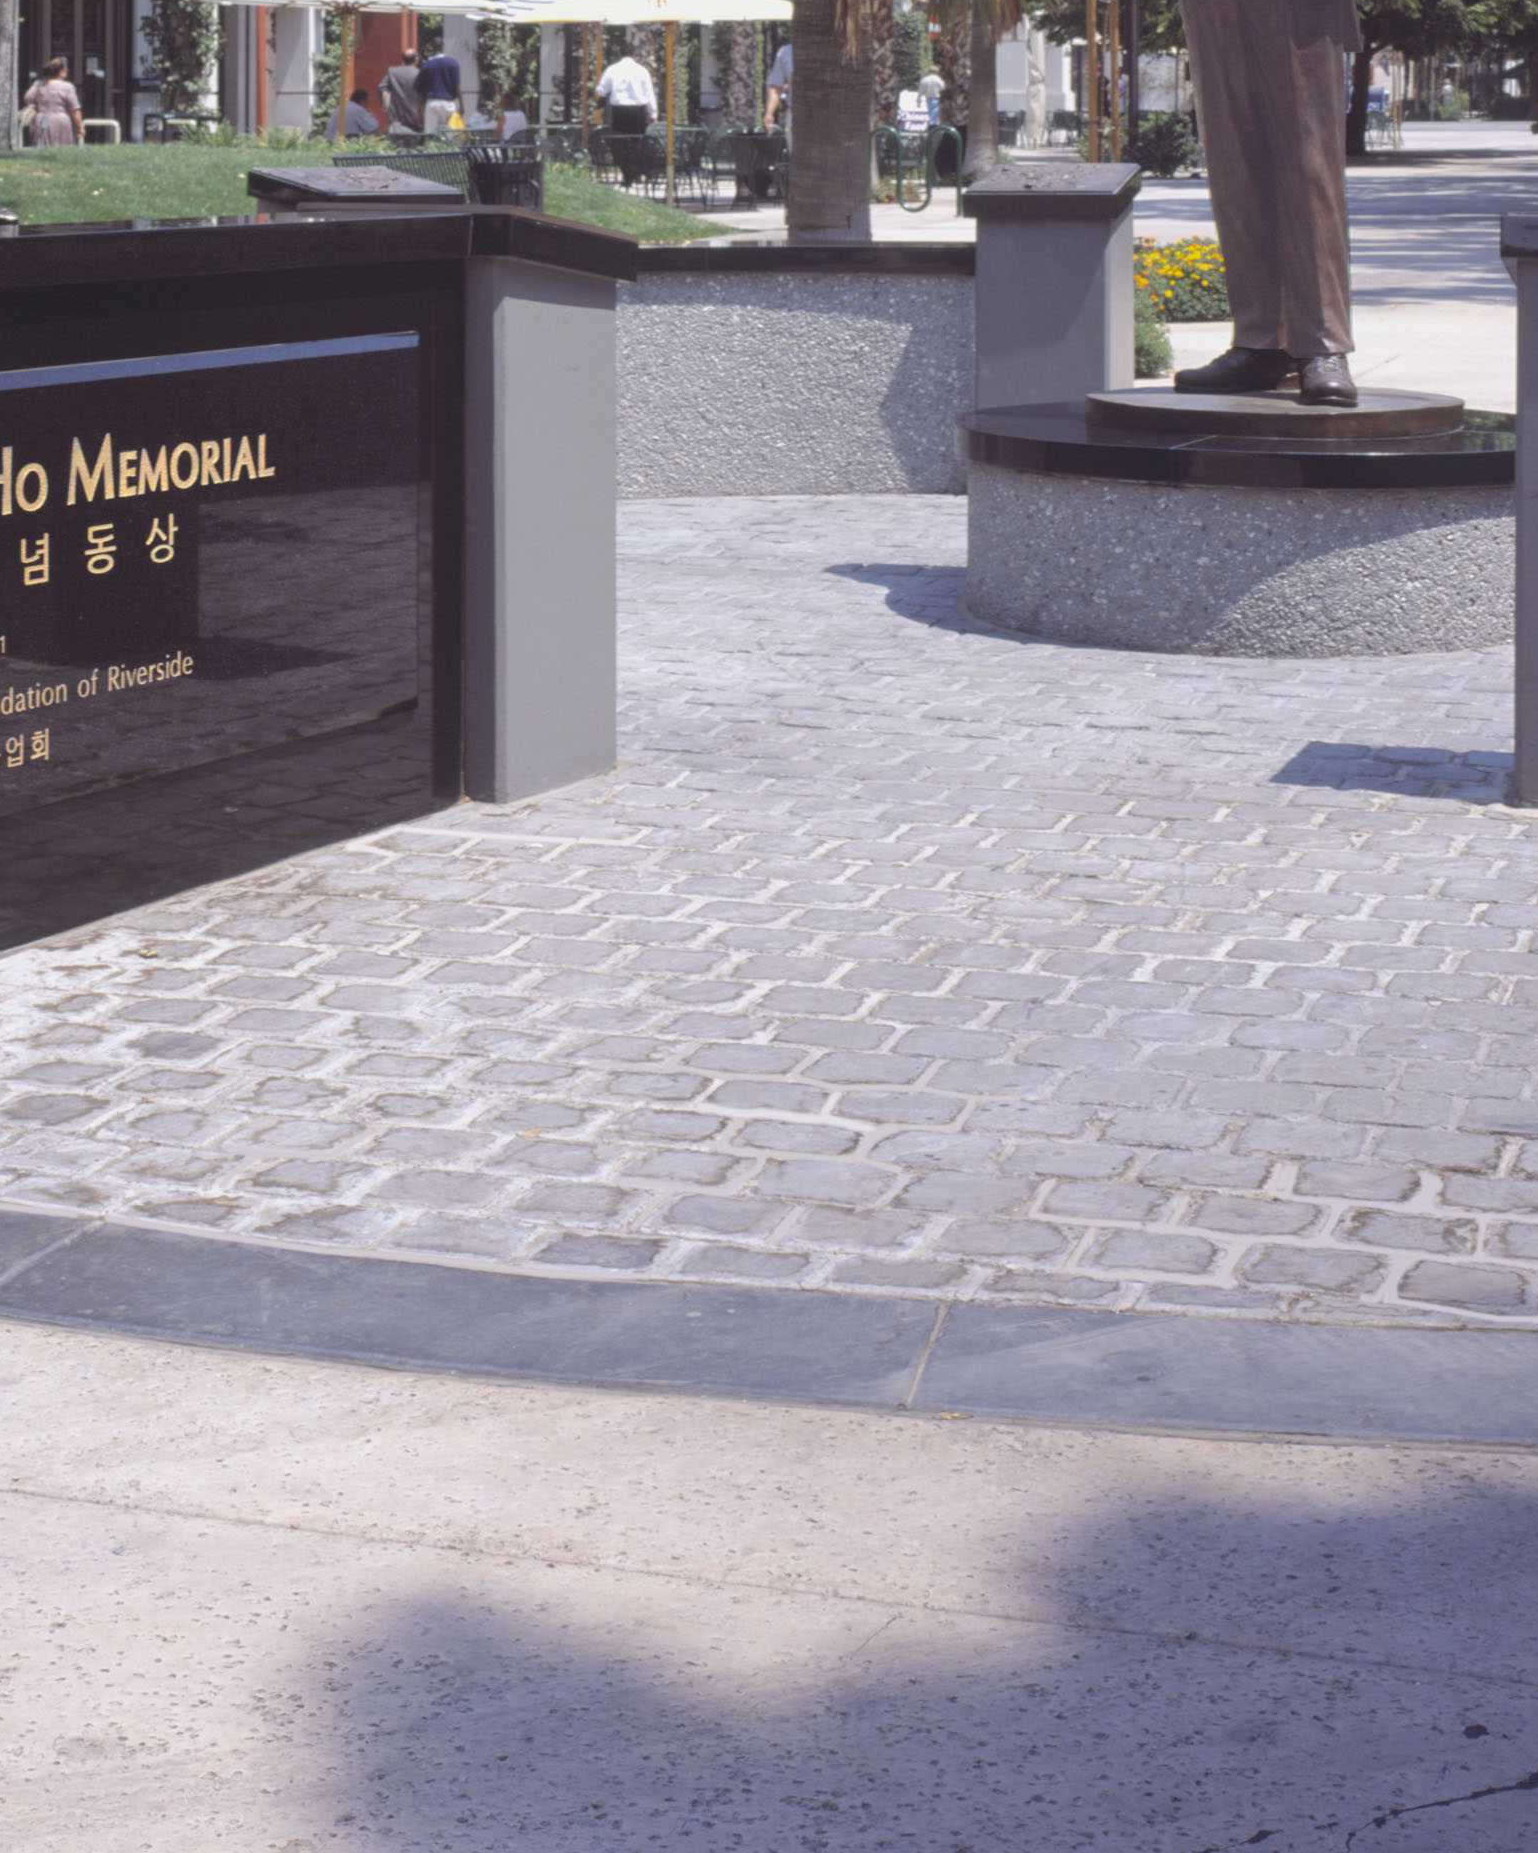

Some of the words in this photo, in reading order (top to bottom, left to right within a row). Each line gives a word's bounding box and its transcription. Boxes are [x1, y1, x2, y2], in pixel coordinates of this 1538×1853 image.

[65, 432, 276, 507] MEMORIAL
[76, 667, 99, 699] of
[107, 650, 194, 692] Riverside
